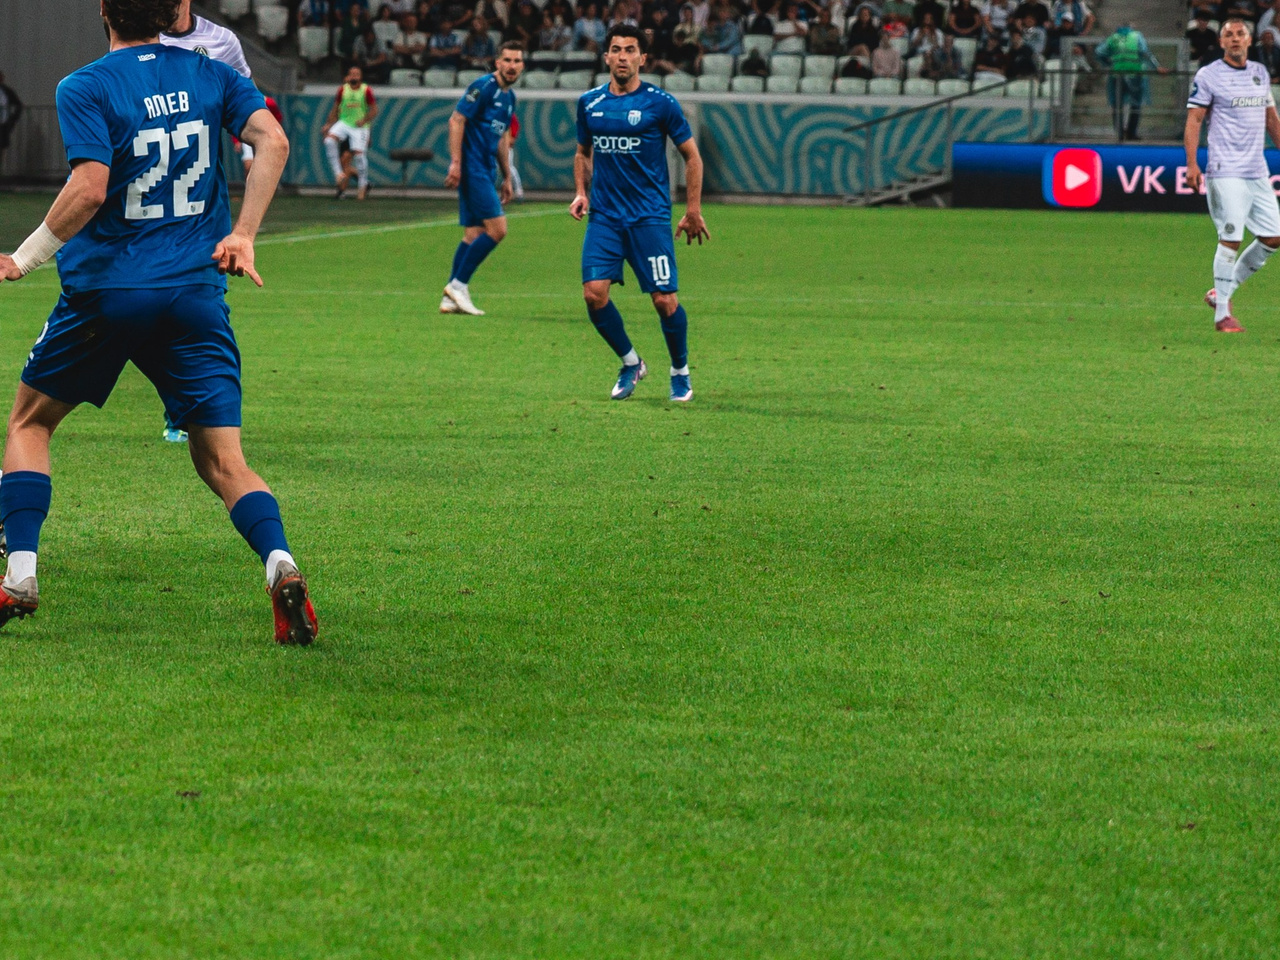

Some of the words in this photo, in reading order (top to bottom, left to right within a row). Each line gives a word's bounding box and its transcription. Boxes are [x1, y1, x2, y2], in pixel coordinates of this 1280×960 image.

[125, 120, 211, 220] 22
[1116, 165, 1167, 194] VK
[648, 255, 671, 281] 10
